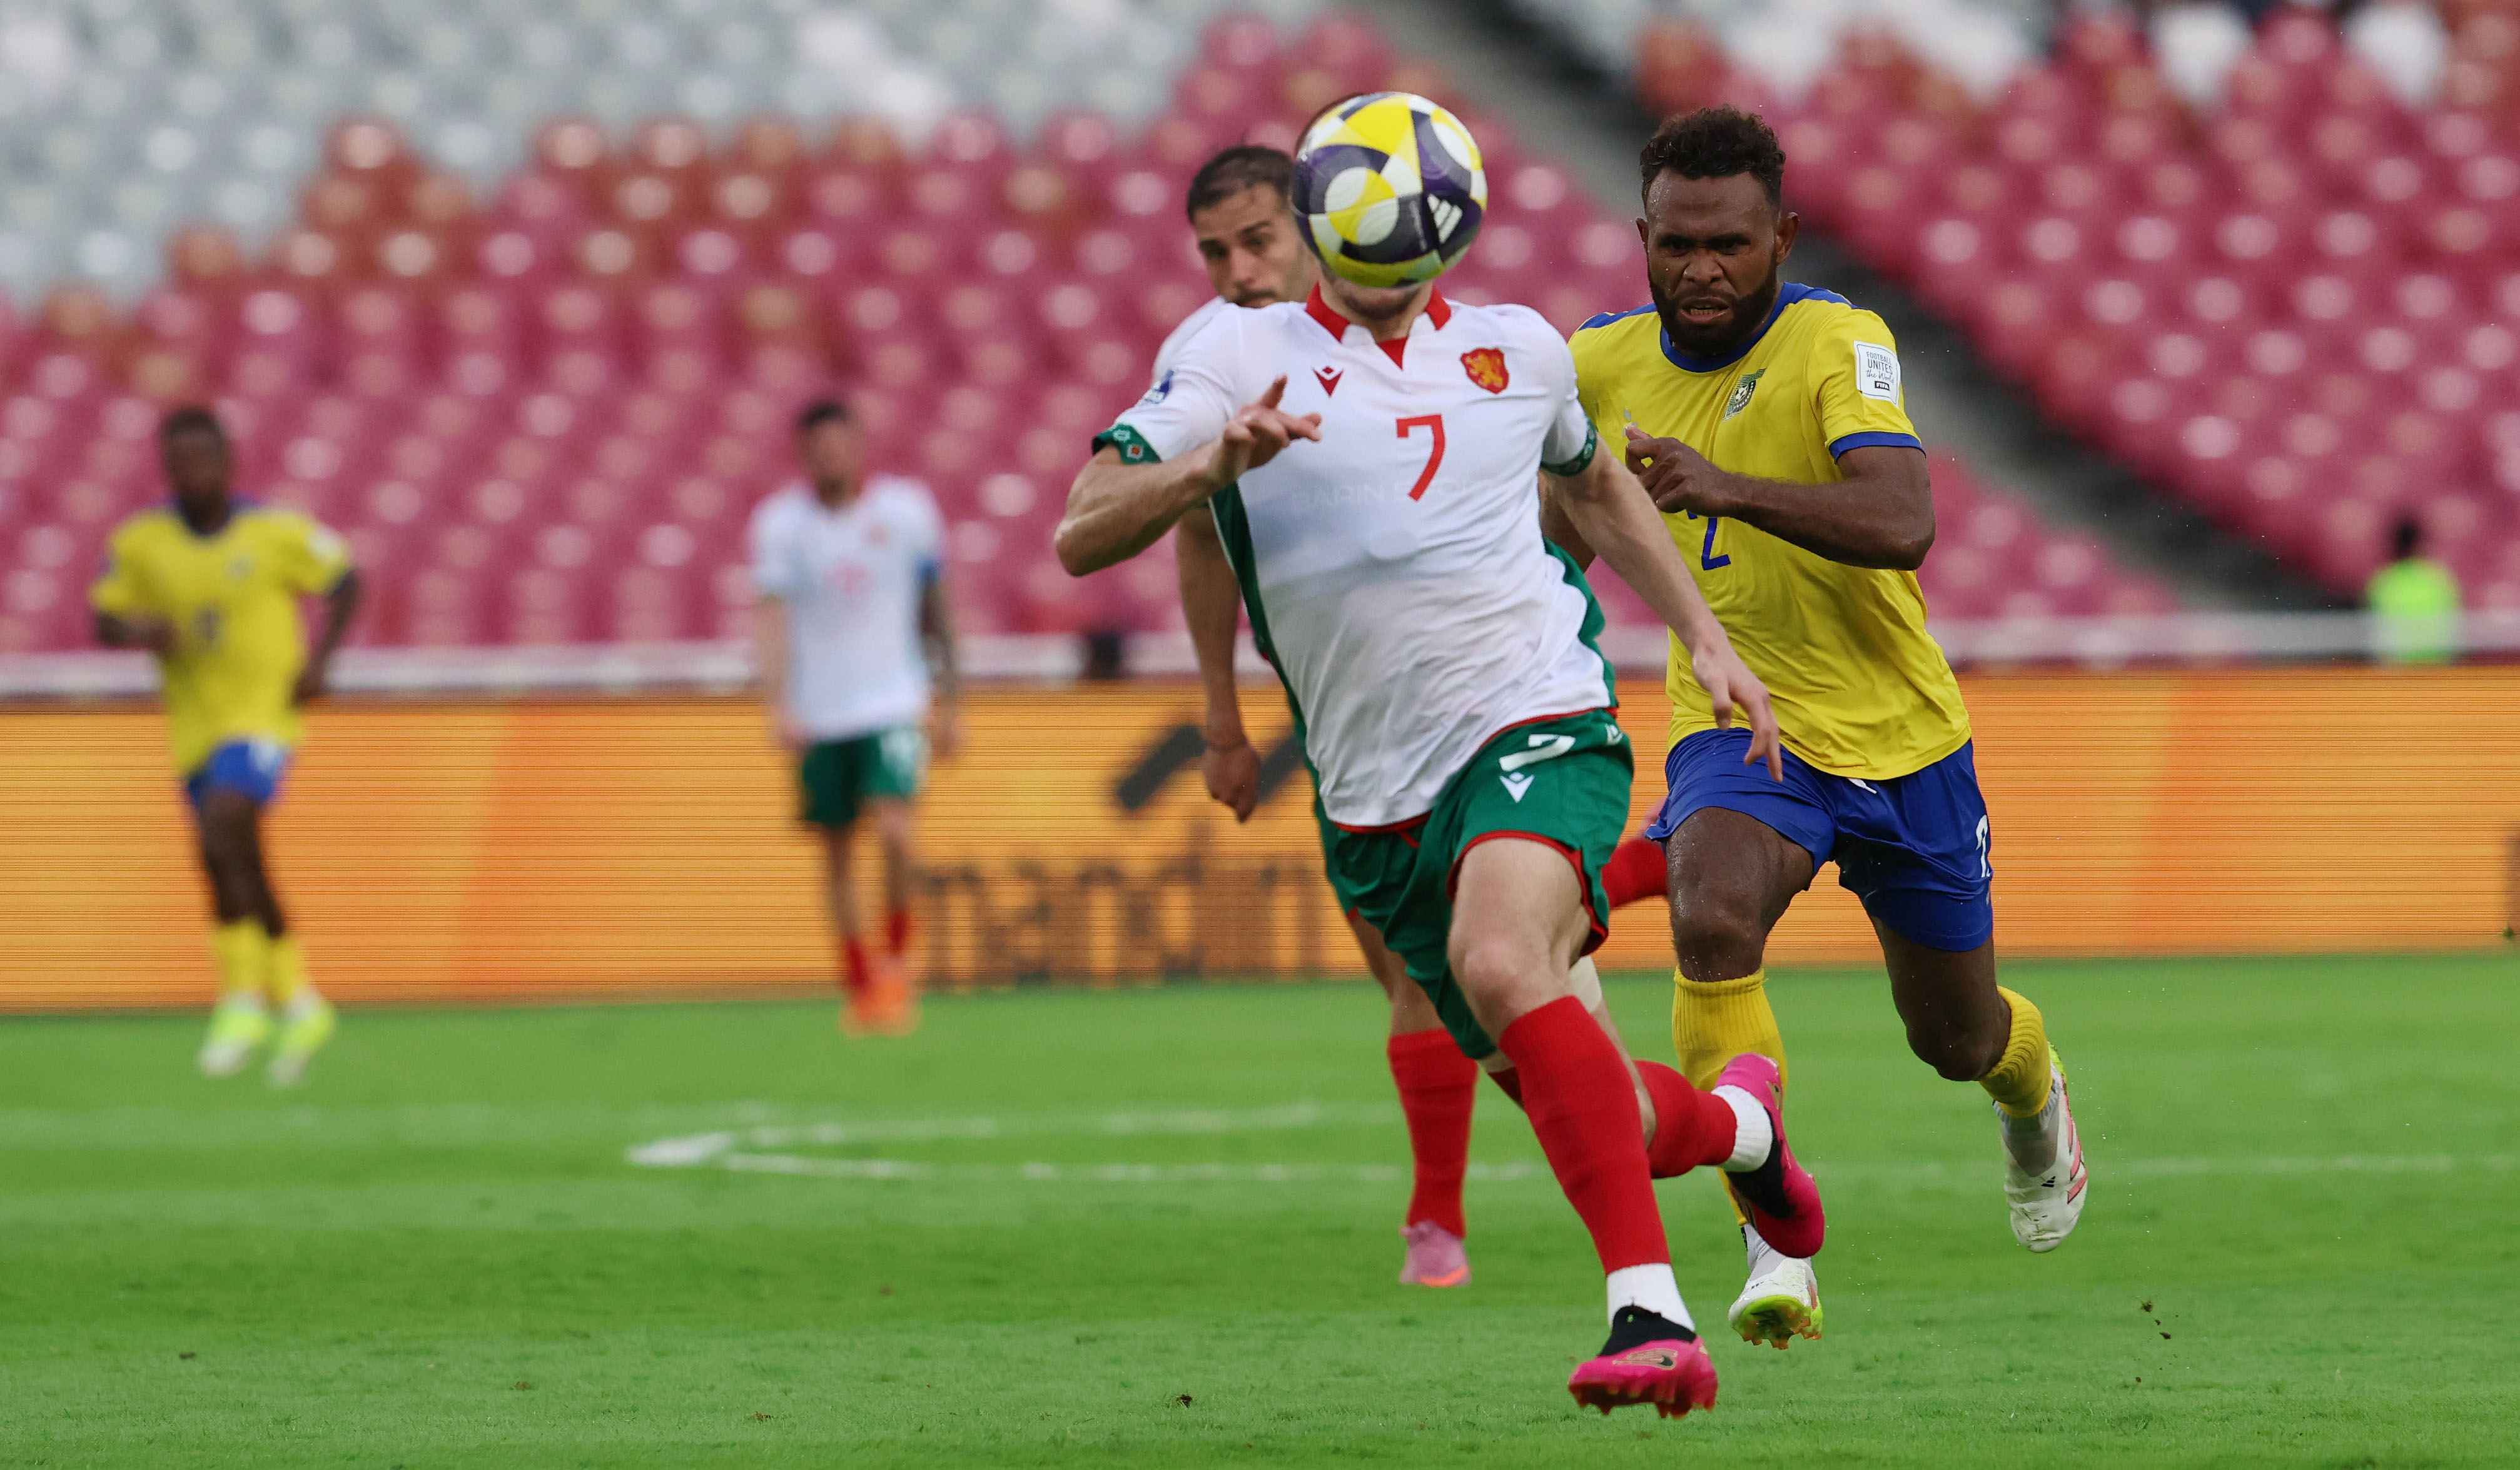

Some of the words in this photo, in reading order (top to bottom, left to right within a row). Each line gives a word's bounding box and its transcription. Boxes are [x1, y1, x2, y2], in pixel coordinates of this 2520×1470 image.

[1866, 351, 1892, 366] FOOTBALL
[1868, 358, 1893, 375] UNITES
[1865, 369, 1877, 378] the
[1878, 371, 1894, 385] World
[1876, 381, 1889, 390] FIFA
[1396, 414, 1446, 501] 7
